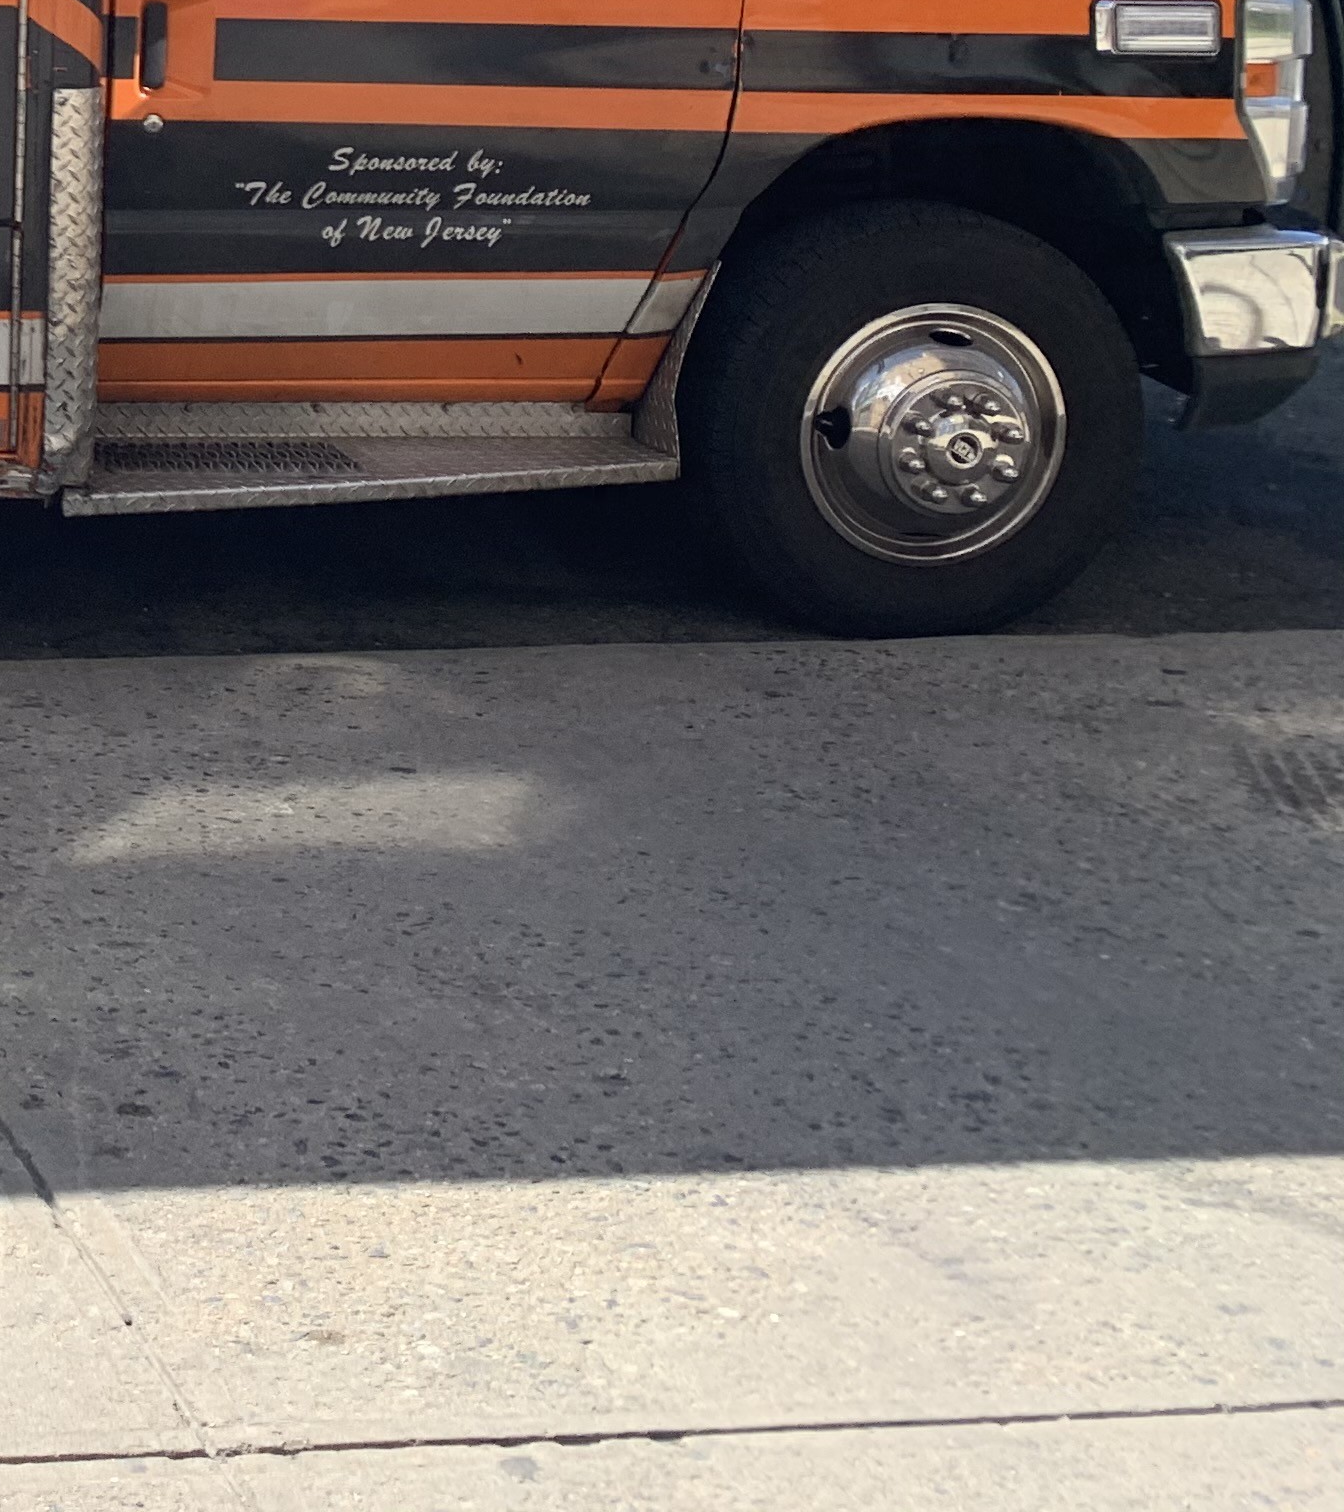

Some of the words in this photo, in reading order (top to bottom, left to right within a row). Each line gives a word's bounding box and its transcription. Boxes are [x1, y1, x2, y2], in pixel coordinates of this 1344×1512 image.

[328, 146, 459, 176] Sponsored
[467, 148, 504, 178] by:
[234, 180, 291, 206] "The
[301, 180, 441, 211] Community
[453, 182, 591, 209] Foundation
[321, 218, 348, 248] of
[356, 215, 413, 241] New
[420, 216, 512, 248] Jersey"
